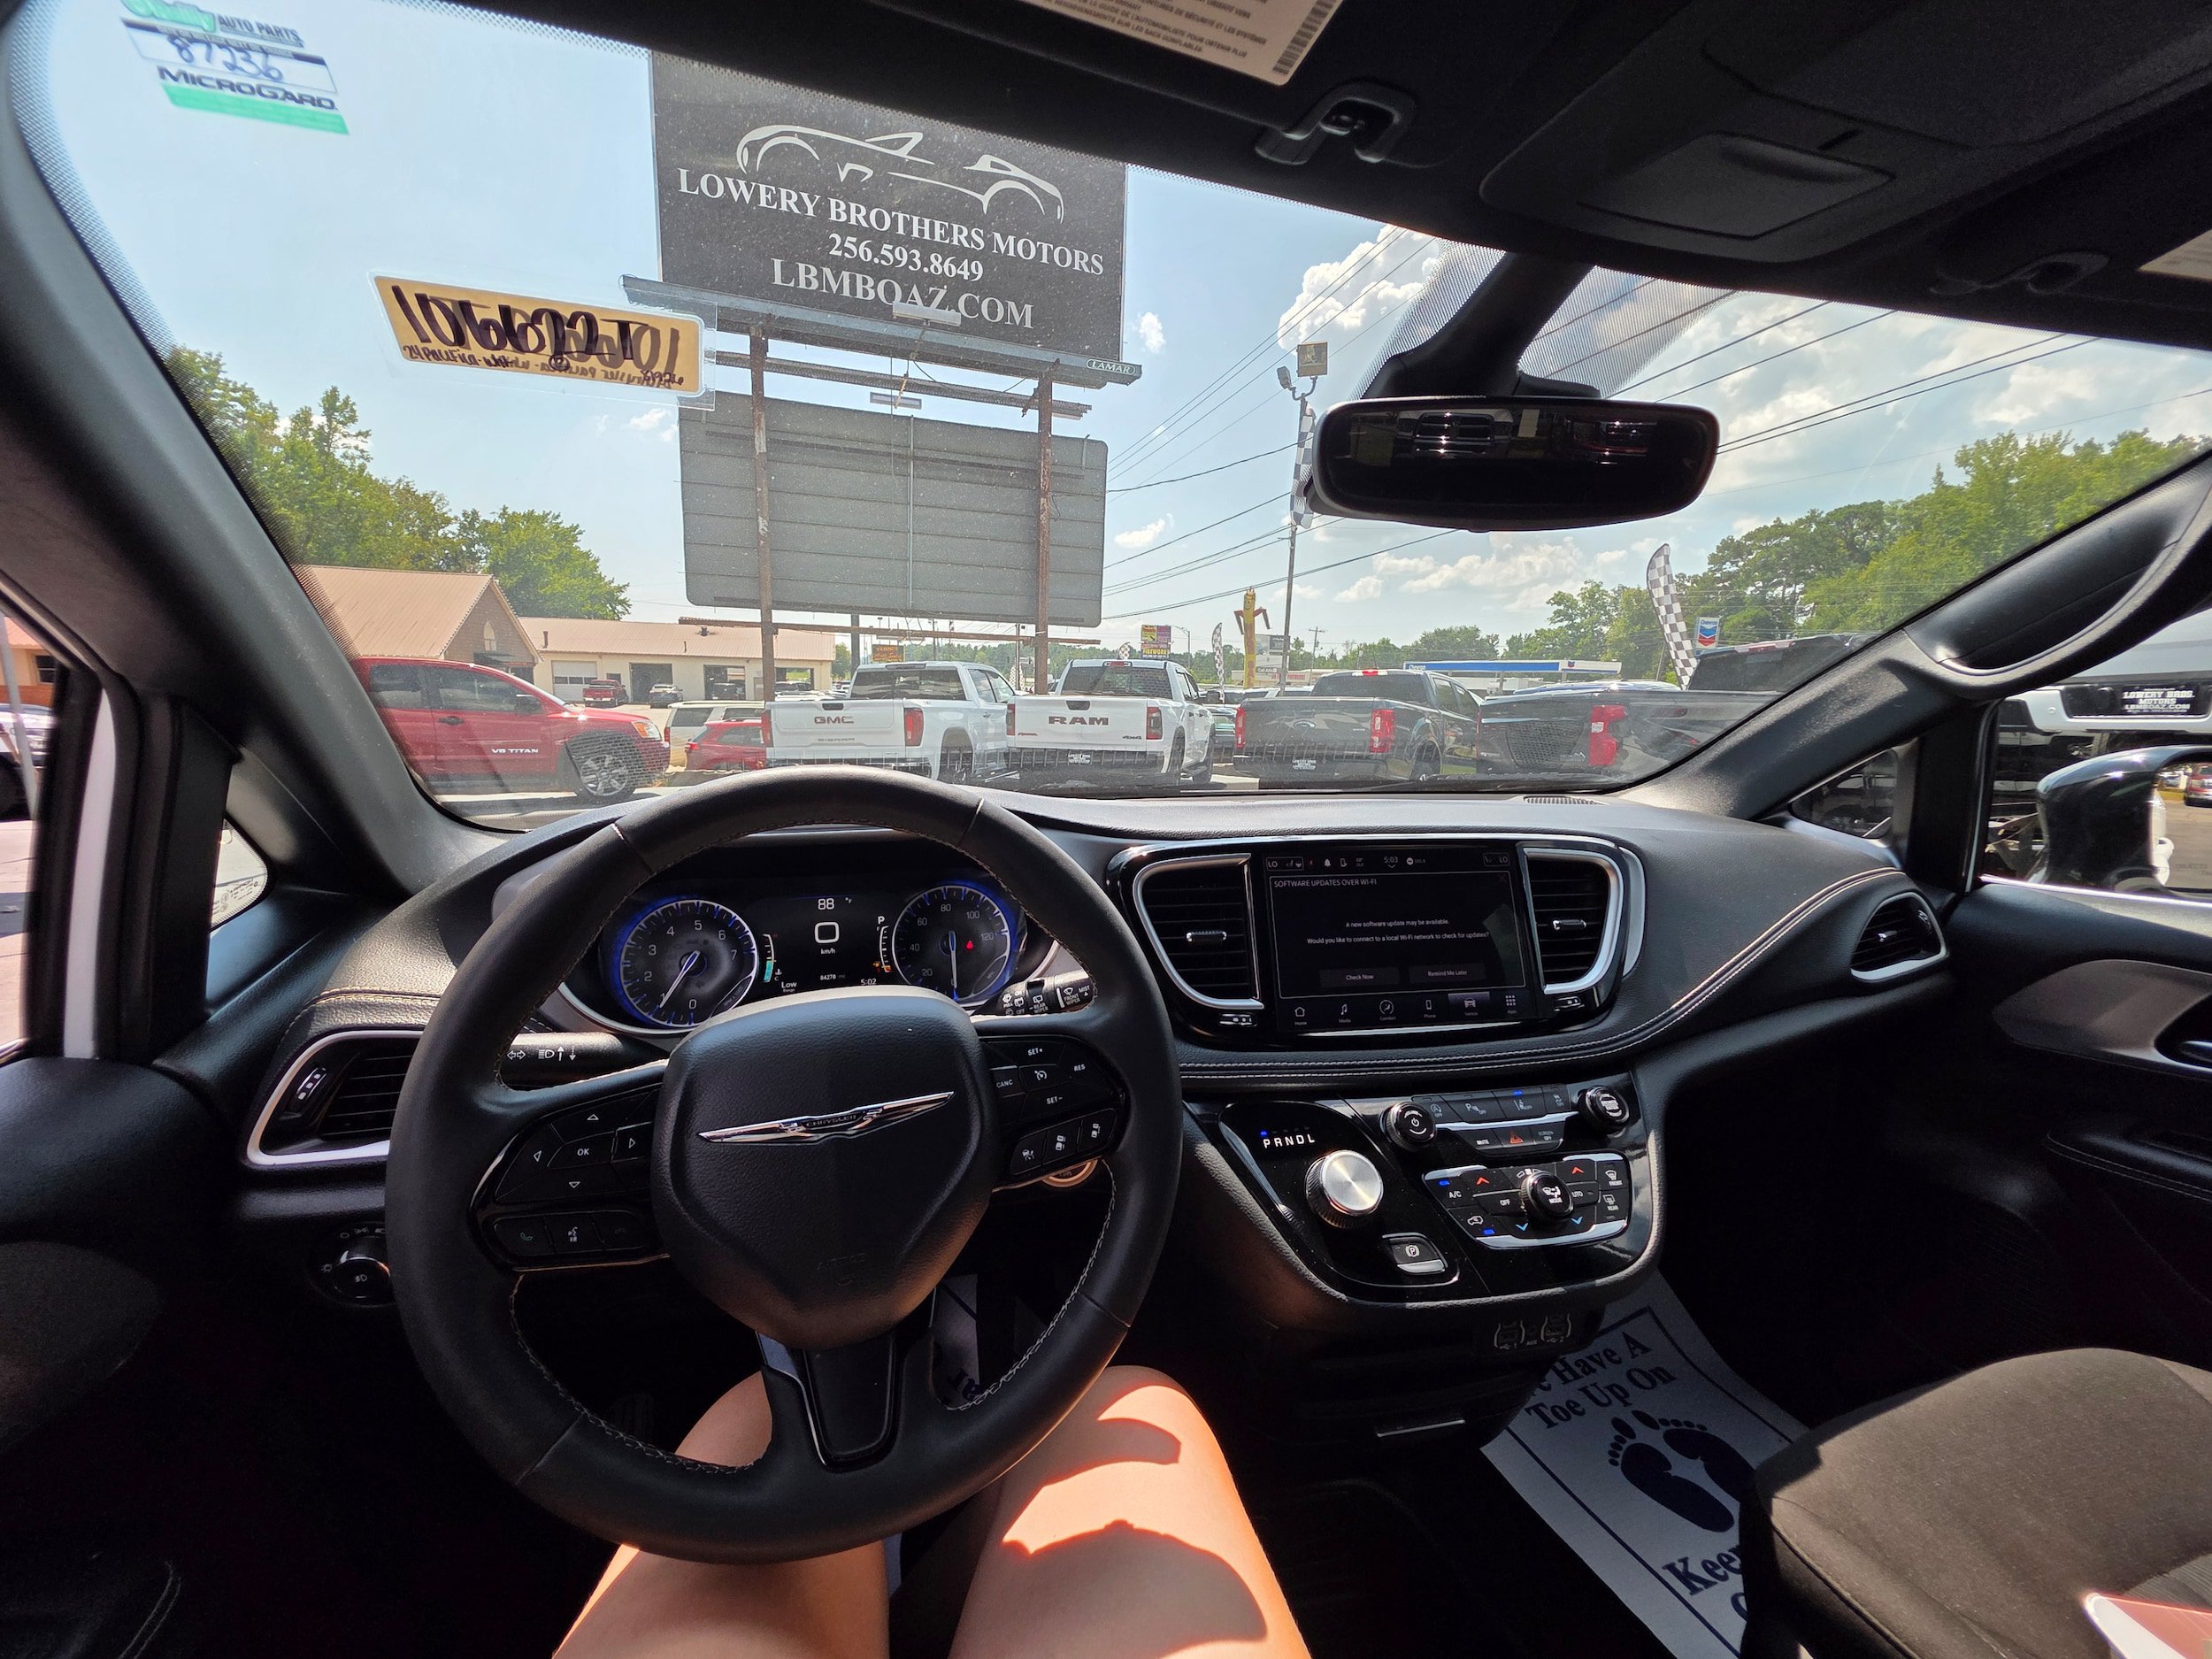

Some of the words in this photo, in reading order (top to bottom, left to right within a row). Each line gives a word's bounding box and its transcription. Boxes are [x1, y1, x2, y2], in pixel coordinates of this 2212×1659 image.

[219, 15, 255, 35] AUTO
[257, 23, 304, 44] PARTS
[157, 65, 338, 111] MICROGARD
[678, 167, 821, 218] LOWERY
[828, 197, 986, 252] BROTHERS
[992, 231, 1104, 277] MOTORS
[828, 233, 984, 282] 256.593.8649
[771, 257, 1034, 330] LBMBOAZ.COM
[1092, 360, 1133, 375] LAMAR
[1048, 716, 1109, 726] RAM
[1274, 879, 1310, 888] SOFTWARE
[1341, 878, 1360, 887] OVER
[818, 898, 835, 910] 88
[941, 903, 951, 912] 80
[966, 910, 979, 919] 100
[695, 920, 703, 931] 5
[877, 916, 885, 925] P
[917, 918, 928, 926] 60
[666, 926, 675, 936] 4
[718, 930, 726, 941] 6
[814, 921, 840, 944] 0
[980, 933, 995, 941] 120
[649, 944, 657, 956] 3
[910, 943, 920, 952] 40
[730, 949, 738, 960] 7
[644, 972, 652, 982] 2
[922, 968, 933, 977] 20
[1064, 993, 1079, 1002] FRONT
[689, 999, 697, 1010] 0
[1073, 1064, 1087, 1072] RES
[996, 1079, 1014, 1089] CANC
[805, 1114, 857, 1128] CHRYSLER
[577, 1148, 590, 1156] OK
[1448, 1190, 1462, 1199] A/C
[1549, 1348, 1623, 1386] Have
[1622, 1331, 1654, 1359] A
[1525, 1399, 1586, 1429] Toe
[1578, 1381, 1633, 1408] Up
[1626, 1366, 1678, 1391] On
